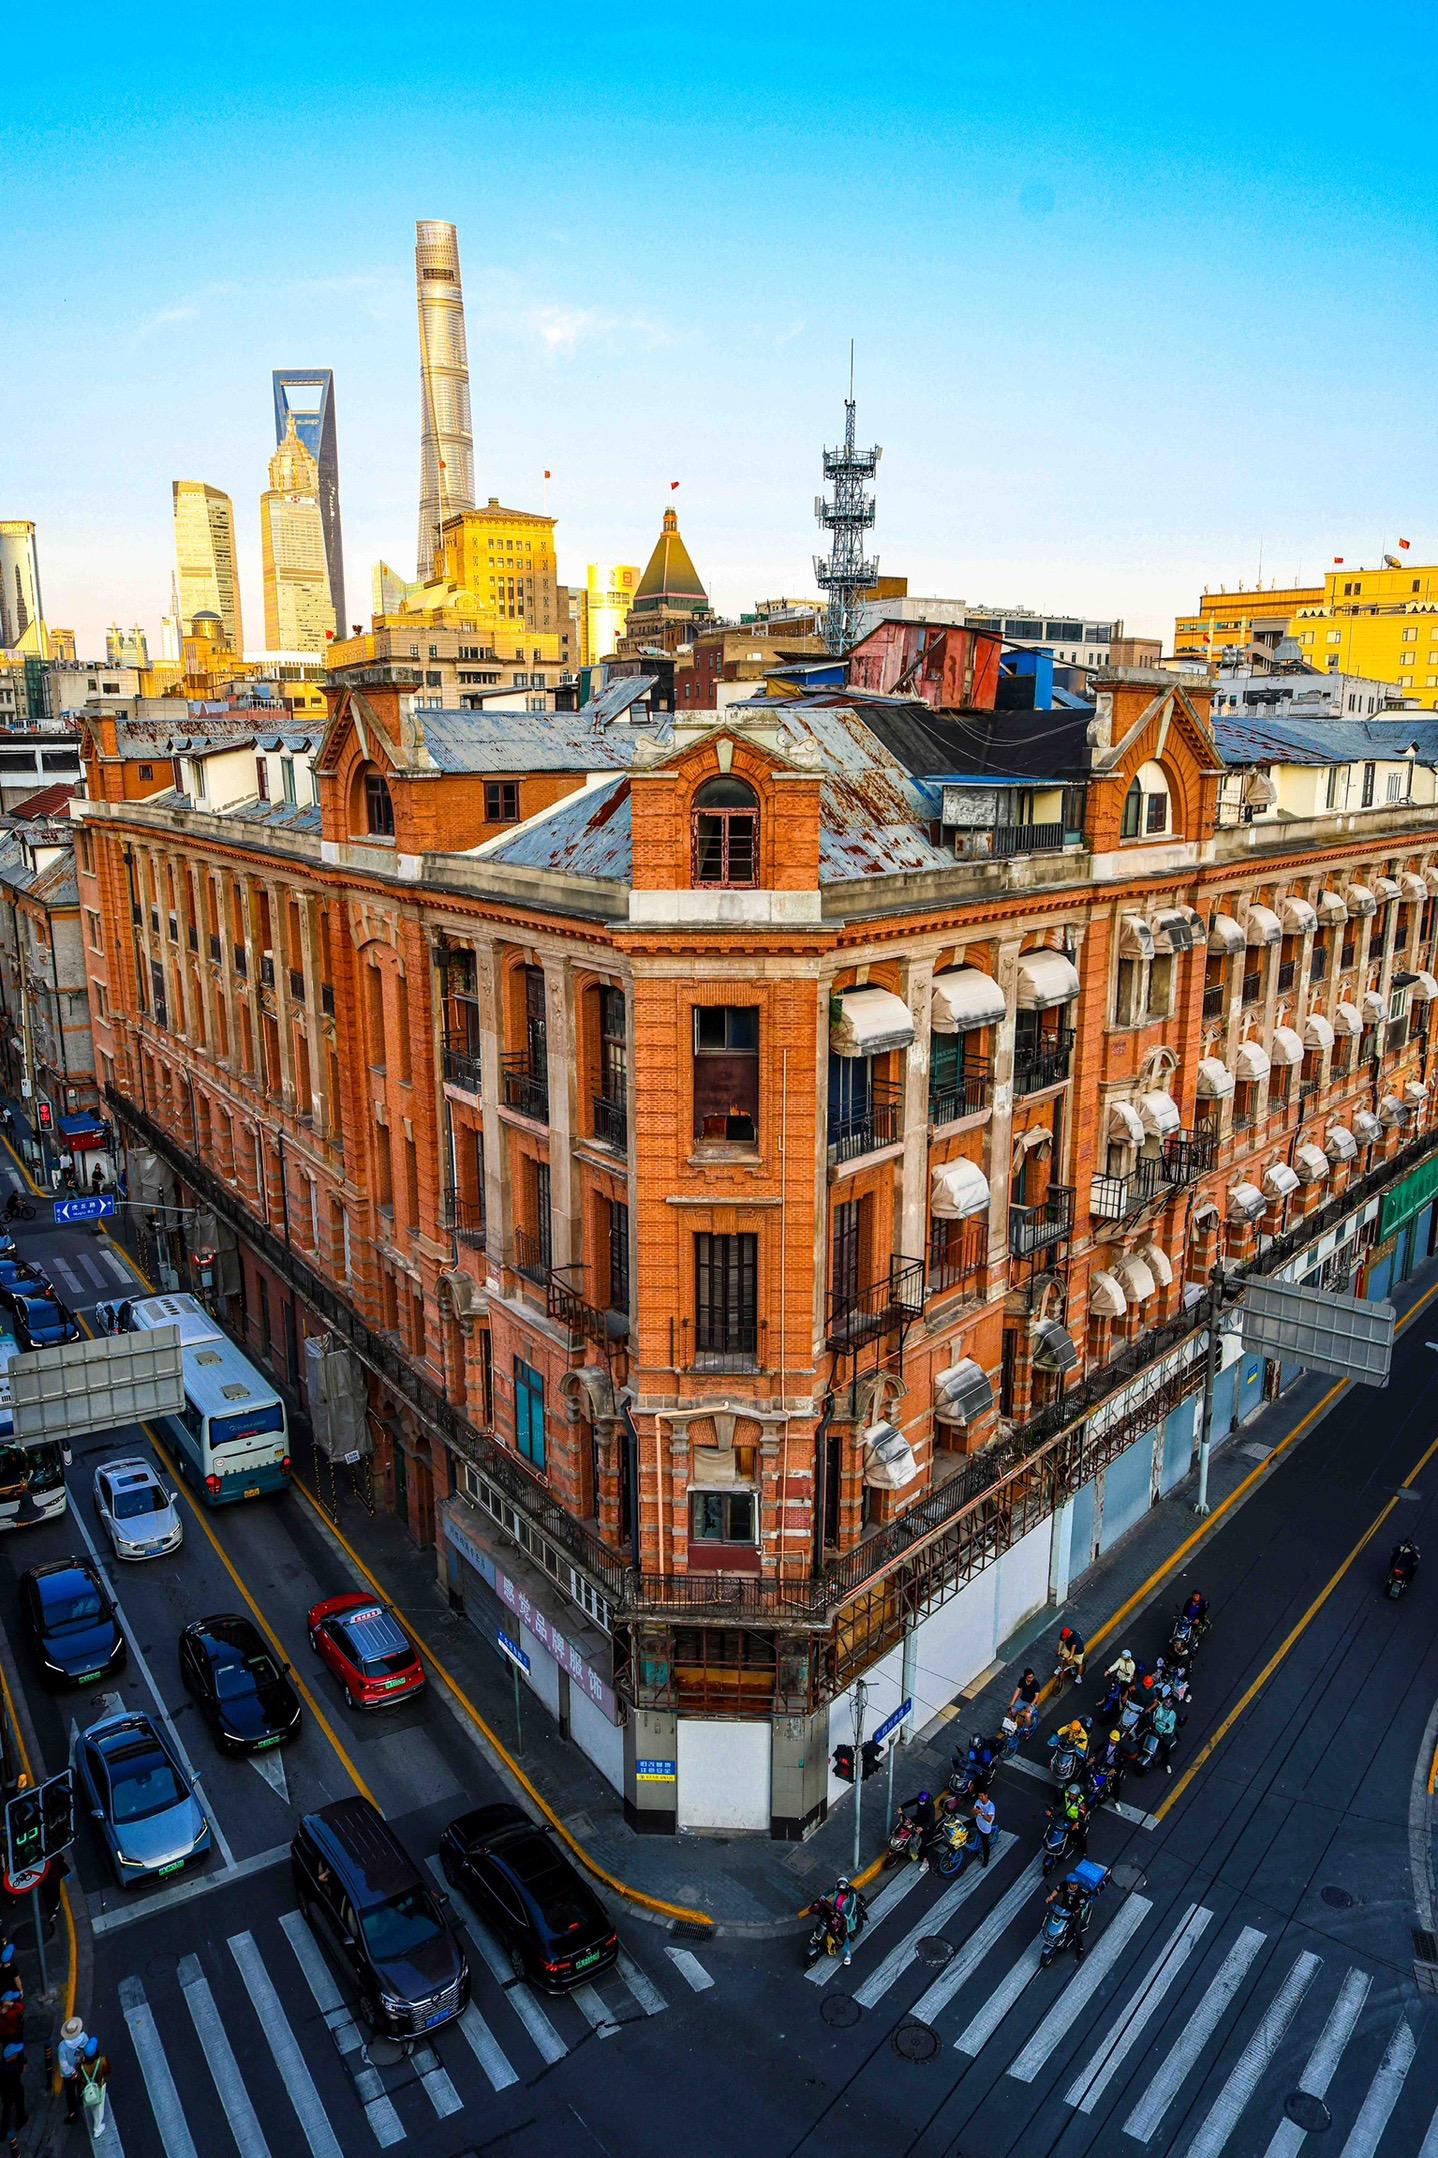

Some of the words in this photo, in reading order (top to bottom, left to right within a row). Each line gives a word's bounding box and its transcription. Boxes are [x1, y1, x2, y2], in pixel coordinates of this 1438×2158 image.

[503, 1575, 602, 1701] 感觉品牌服饰
